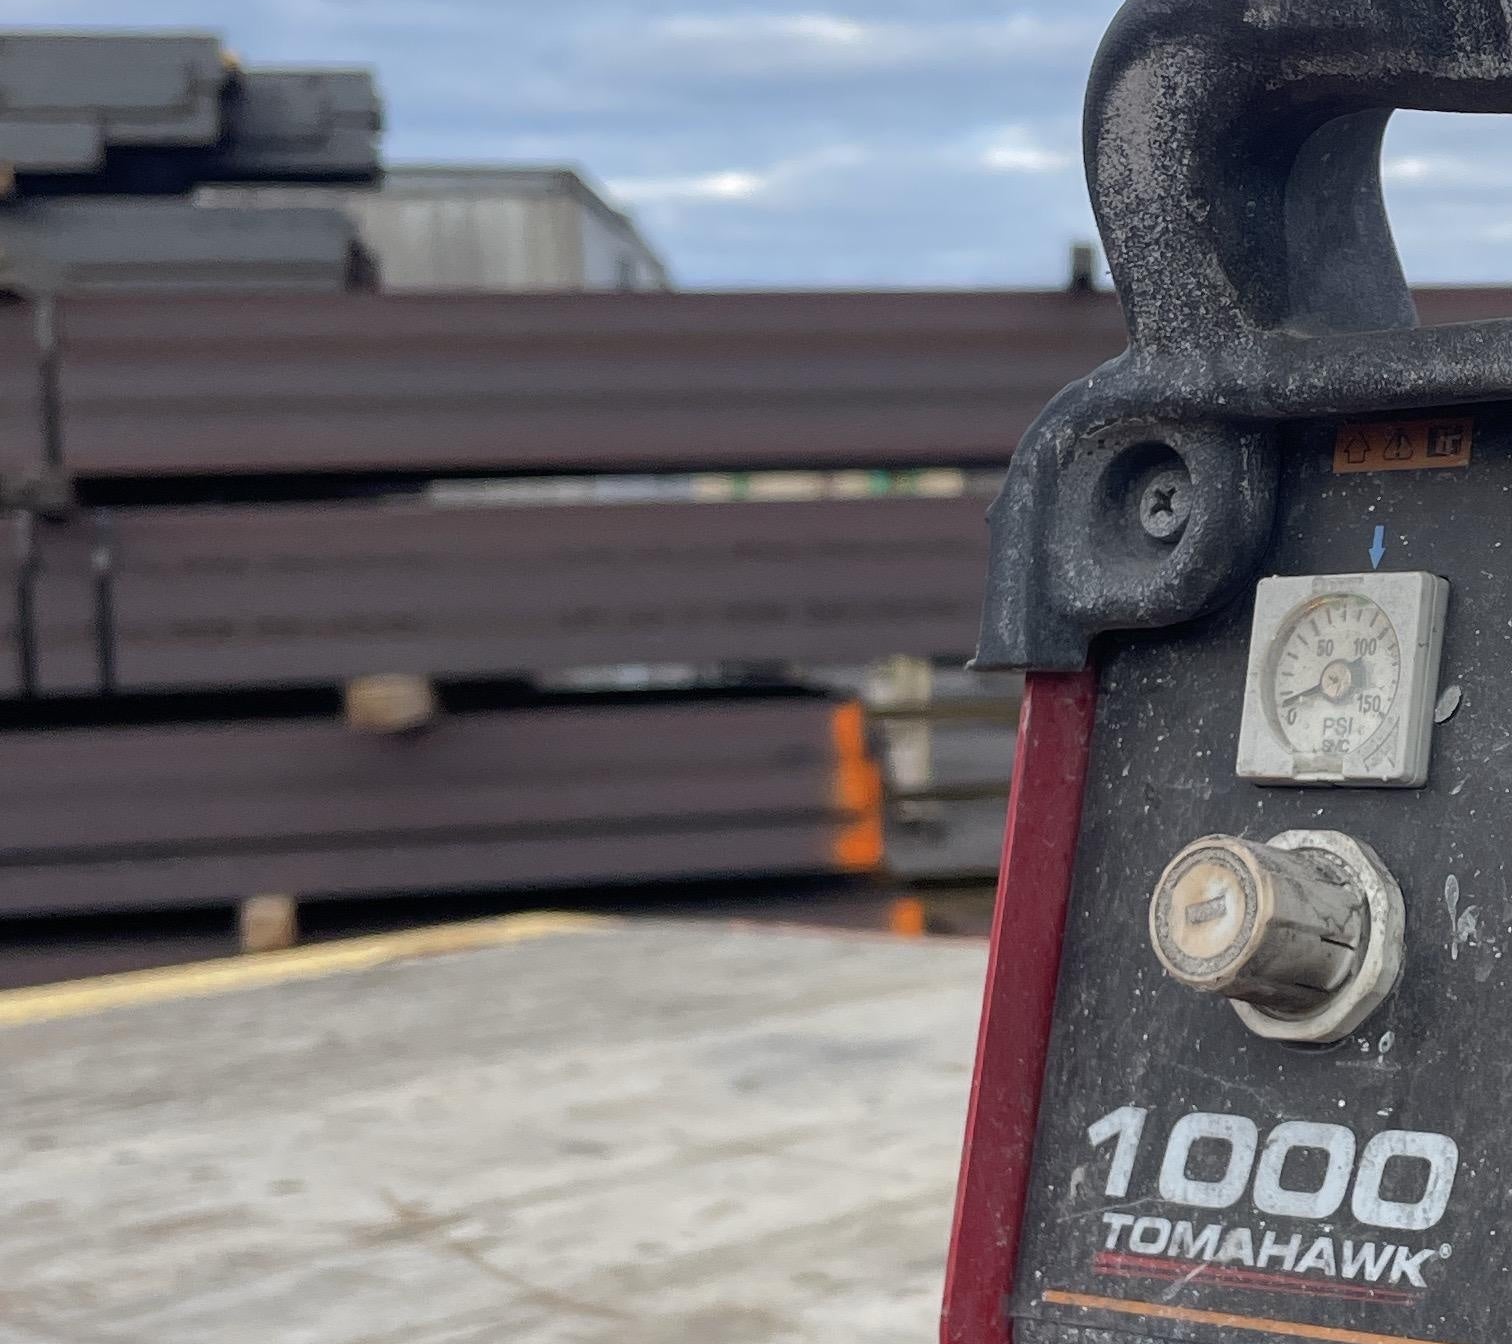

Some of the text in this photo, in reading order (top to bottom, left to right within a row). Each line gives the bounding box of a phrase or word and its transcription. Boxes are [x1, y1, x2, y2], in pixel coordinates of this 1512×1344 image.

[1316, 638, 1377, 657] 50 100
[1287, 695, 1381, 726] 0 150
[1322, 717, 1353, 736] PSI
[1087, 1106, 1459, 1230] 1000
